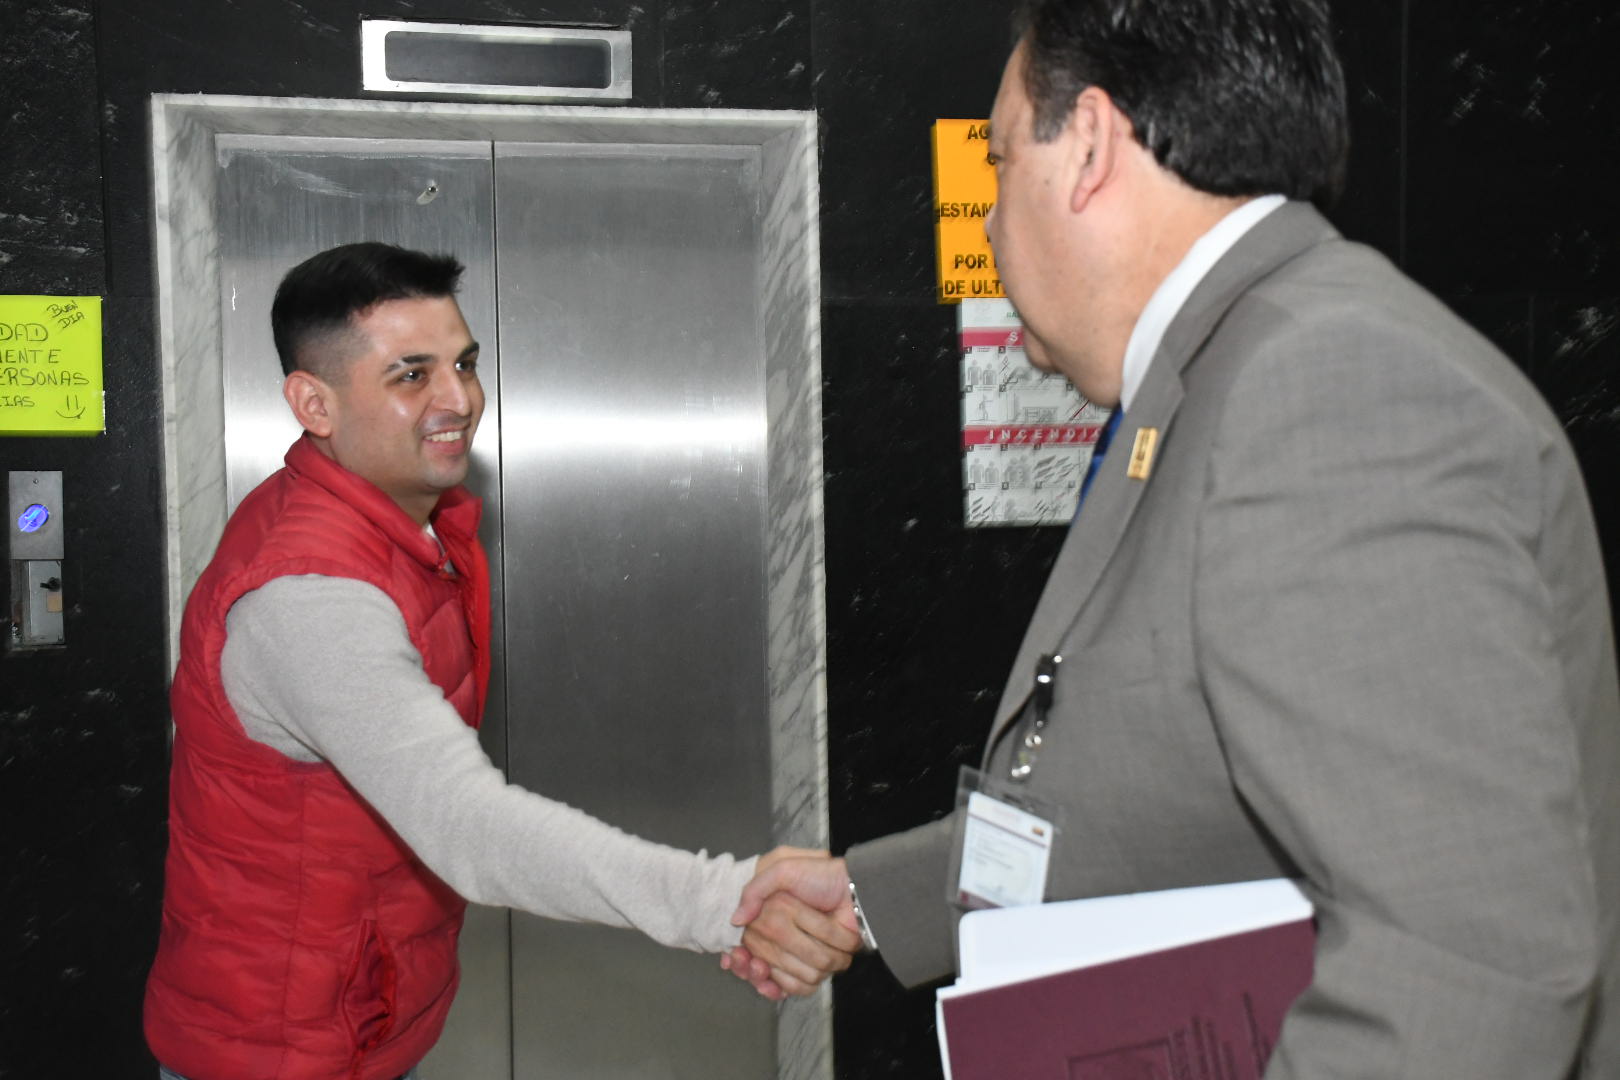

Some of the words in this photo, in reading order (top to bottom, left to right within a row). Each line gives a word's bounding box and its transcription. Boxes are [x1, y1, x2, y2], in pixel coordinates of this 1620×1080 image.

[954, 254, 988, 269] POR
[944, 279, 966, 295] DE
[0, 348, 62, 364] ENTE
[0, 395, 36, 408] IAS
